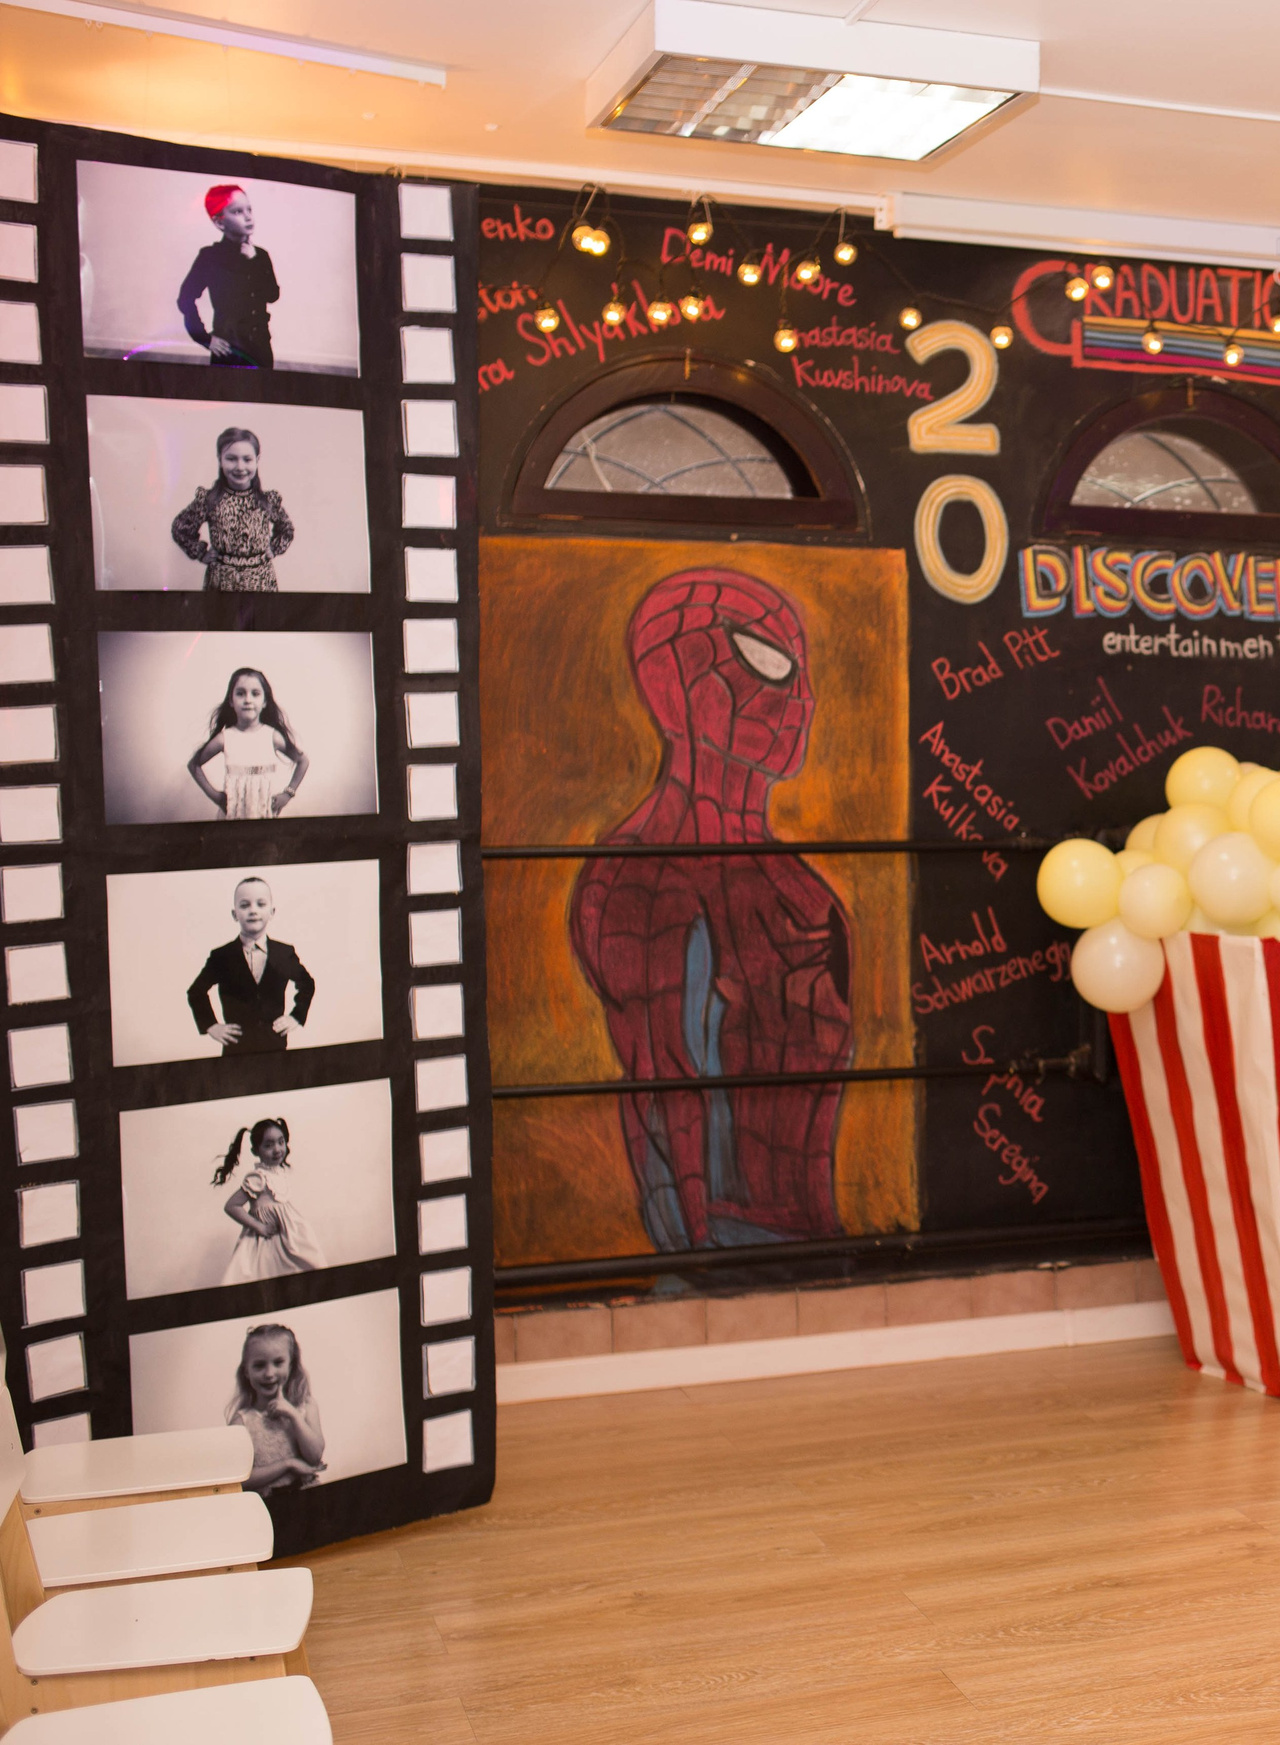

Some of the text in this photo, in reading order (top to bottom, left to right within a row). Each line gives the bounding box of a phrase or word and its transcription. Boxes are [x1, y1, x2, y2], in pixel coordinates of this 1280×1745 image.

[660, 227, 734, 277] Demi
[793, 315, 901, 355] nastasia
[931, 624, 1061, 701] Brad Pitt
[919, 720, 1021, 832] Anastasia
[1066, 704, 1194, 799] Kovalchuk
[919, 905, 1007, 972] Arnold
